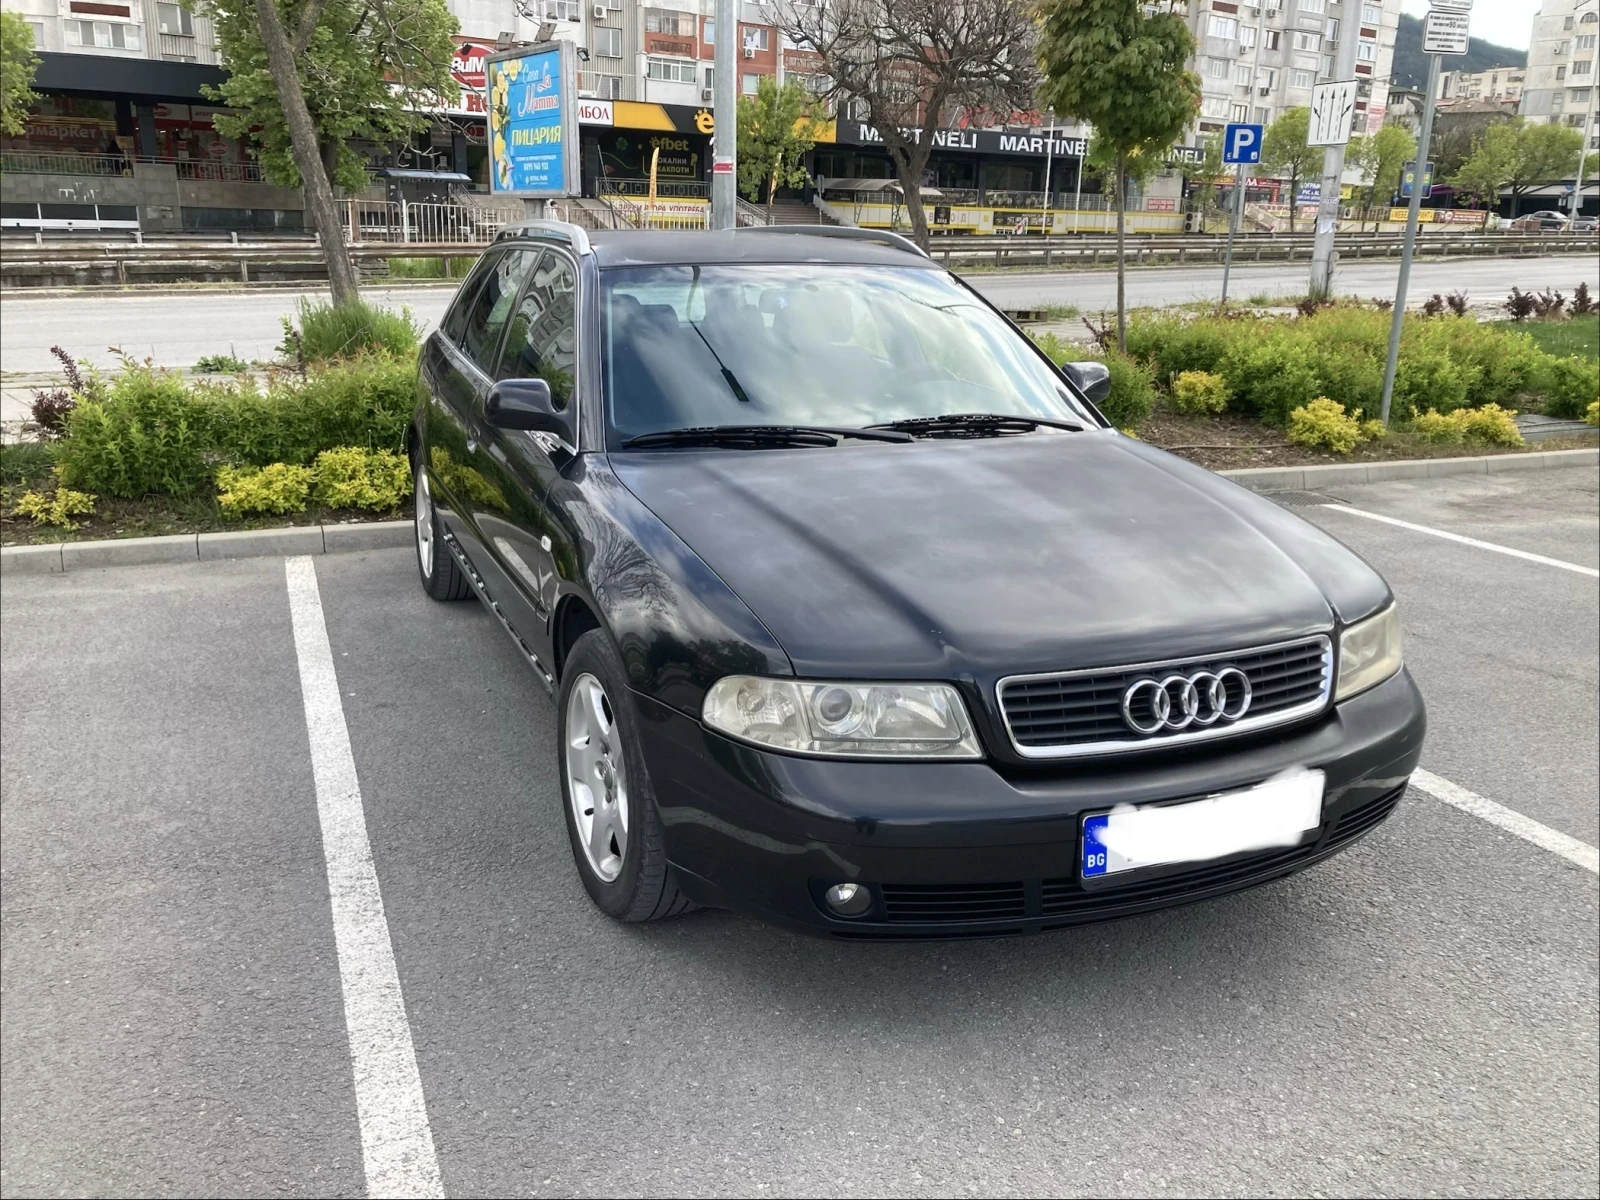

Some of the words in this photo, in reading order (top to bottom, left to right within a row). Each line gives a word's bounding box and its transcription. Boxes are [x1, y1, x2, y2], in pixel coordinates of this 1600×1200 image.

[450, 56, 485, 73] BulM
[517, 83, 559, 117] Mamma
[25, 125, 97, 140] рмаркет
[511, 124, 562, 147] ПИЦАРИЯ
[650, 136, 689, 151] efbet
[999, 135, 1091, 156] MARTINE
[1232, 128, 1255, 159] P
[657, 156, 687, 165] ОКАЛНИ
[1087, 853, 1105, 868] BG
